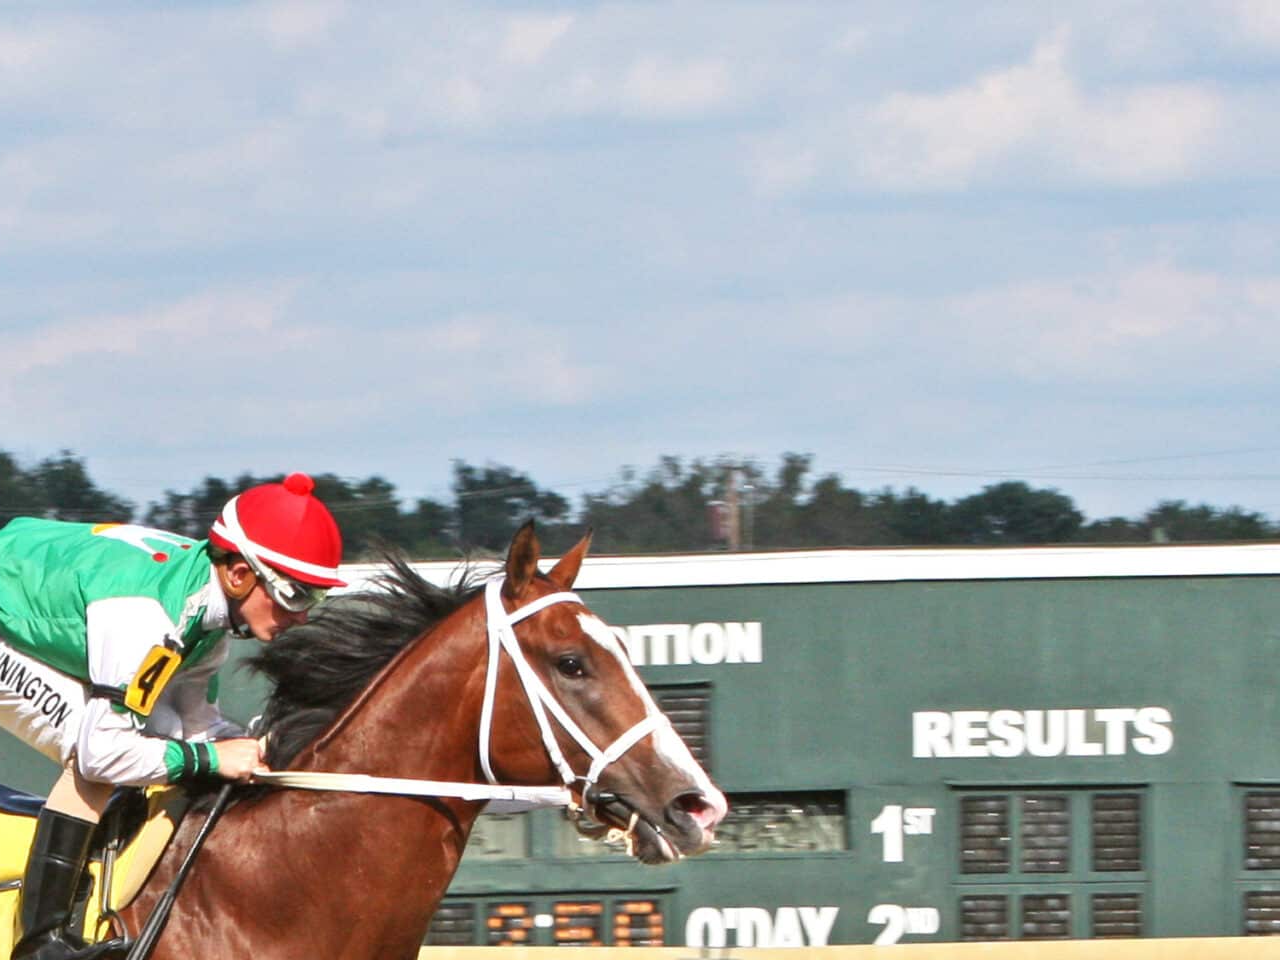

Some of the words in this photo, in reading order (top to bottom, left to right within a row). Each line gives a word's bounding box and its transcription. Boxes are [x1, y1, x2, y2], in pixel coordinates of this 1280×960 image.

[138, 655, 171, 708] 4
[912, 706, 1174, 758] RESULTS
[870, 804, 937, 863] 1ST
[685, 906, 841, 947] O'DAY
